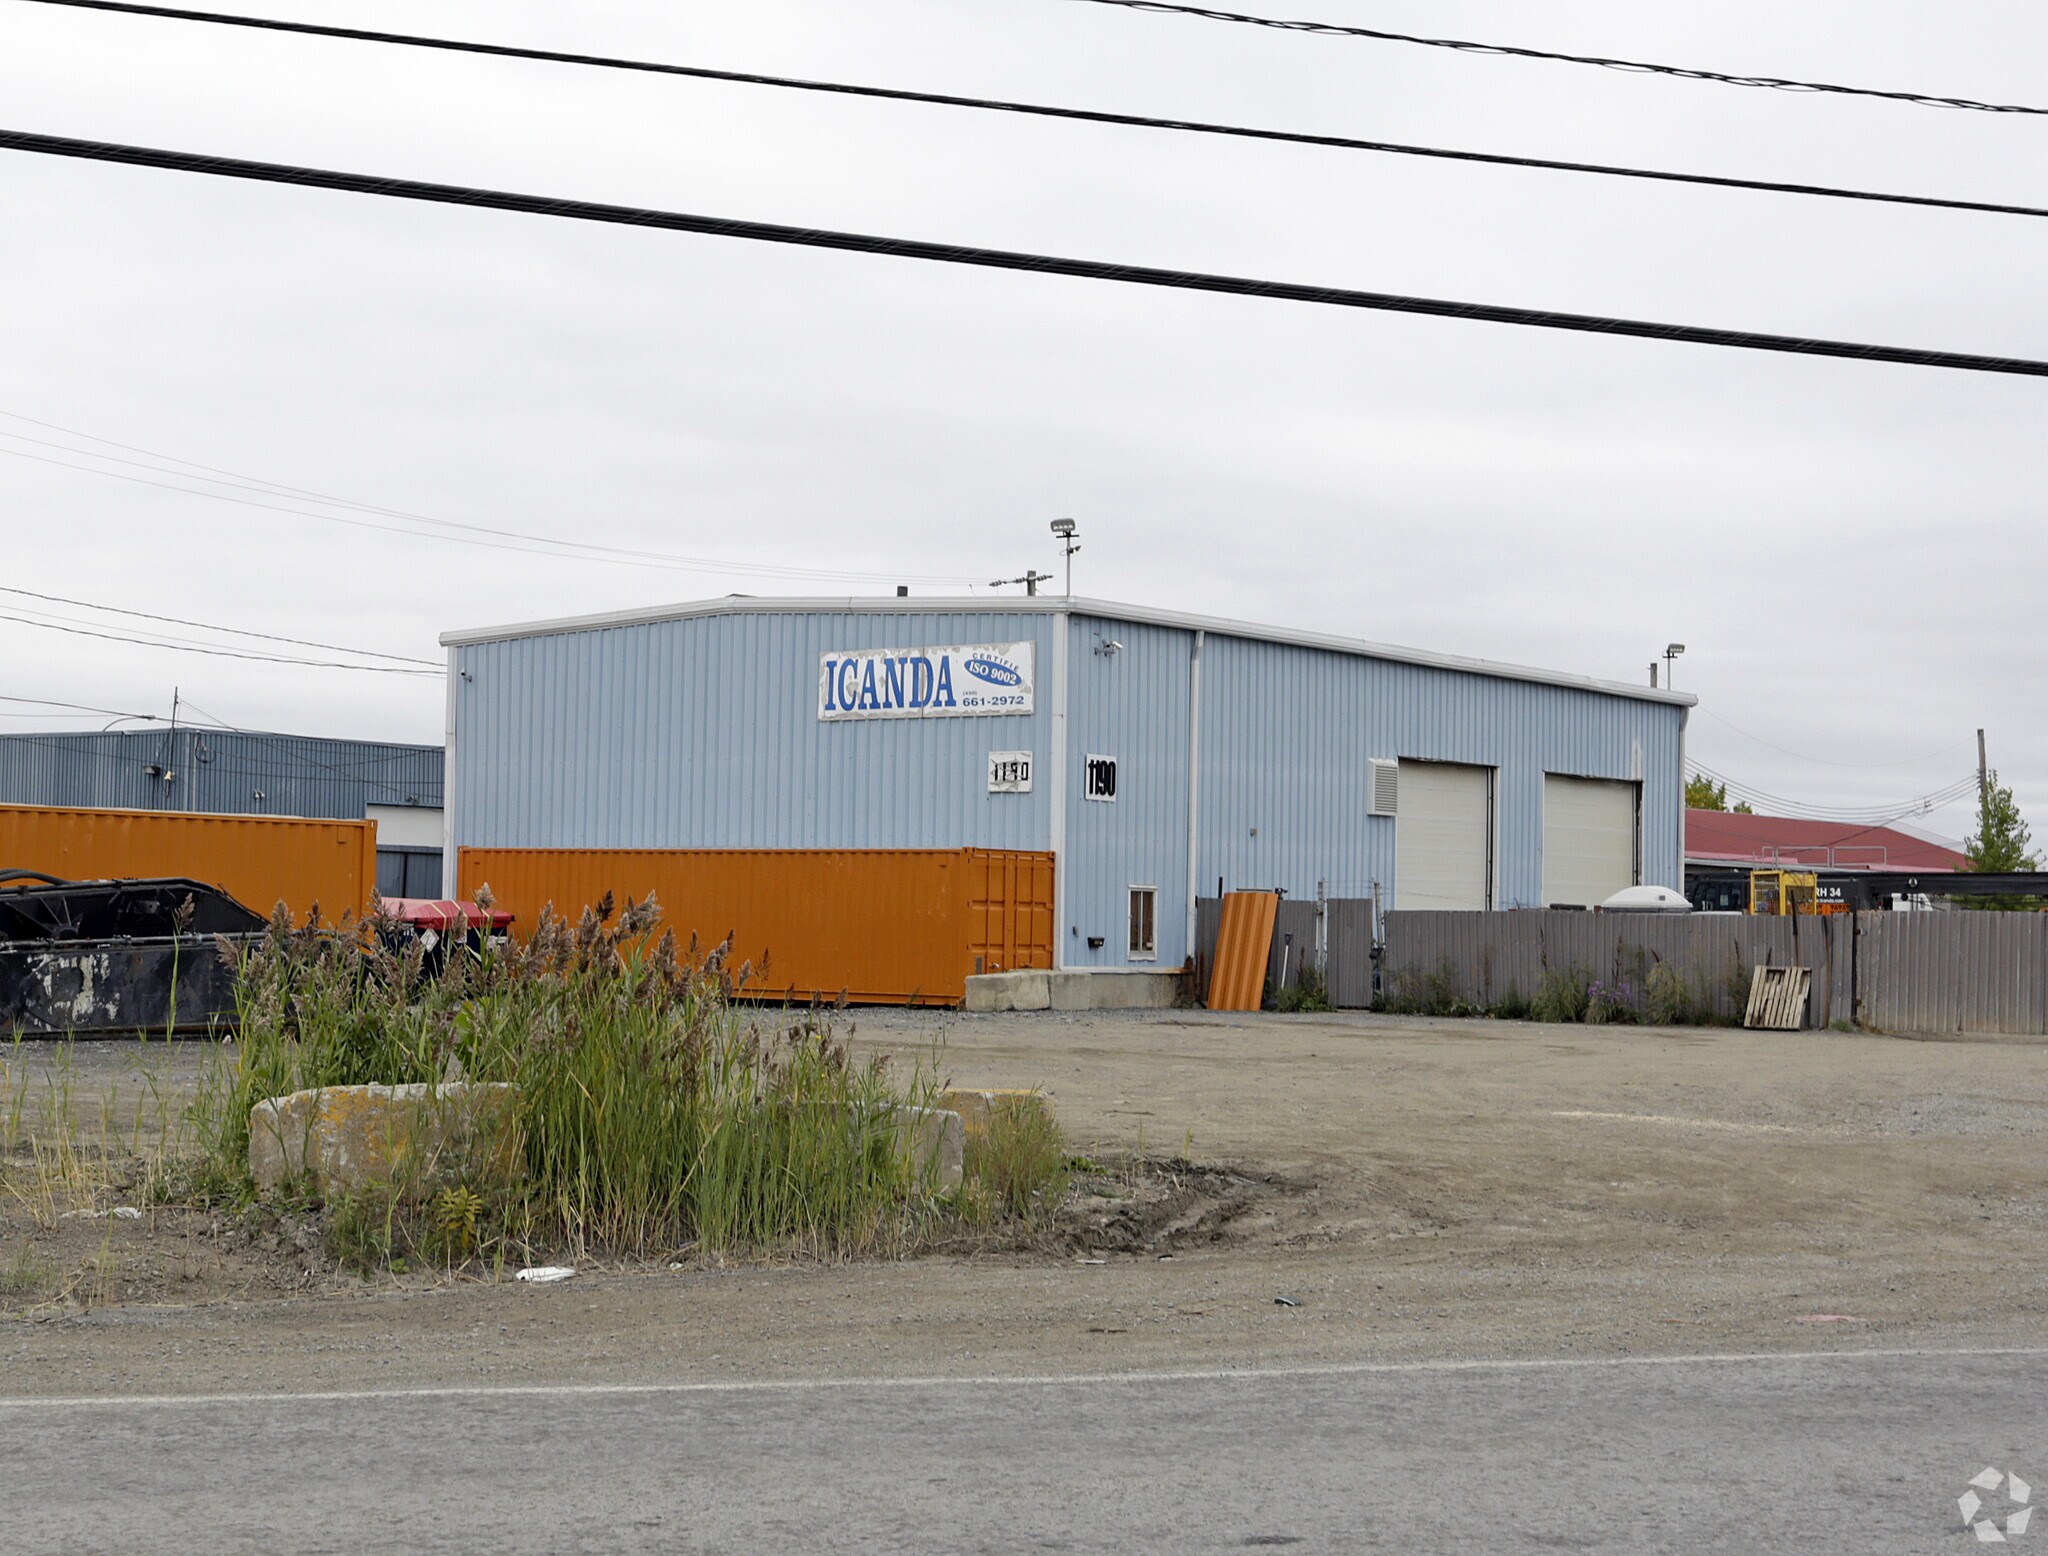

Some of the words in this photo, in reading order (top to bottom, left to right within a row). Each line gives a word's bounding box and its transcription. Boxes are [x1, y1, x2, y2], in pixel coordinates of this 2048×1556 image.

[824, 655, 957, 711] ICANDA
[969, 660, 989, 676] ISO
[990, 667, 1017, 685] 9002
[962, 695, 1025, 707] 661-2972
[1088, 759, 1117, 796] 1190
[1829, 887, 1842, 897] 34
